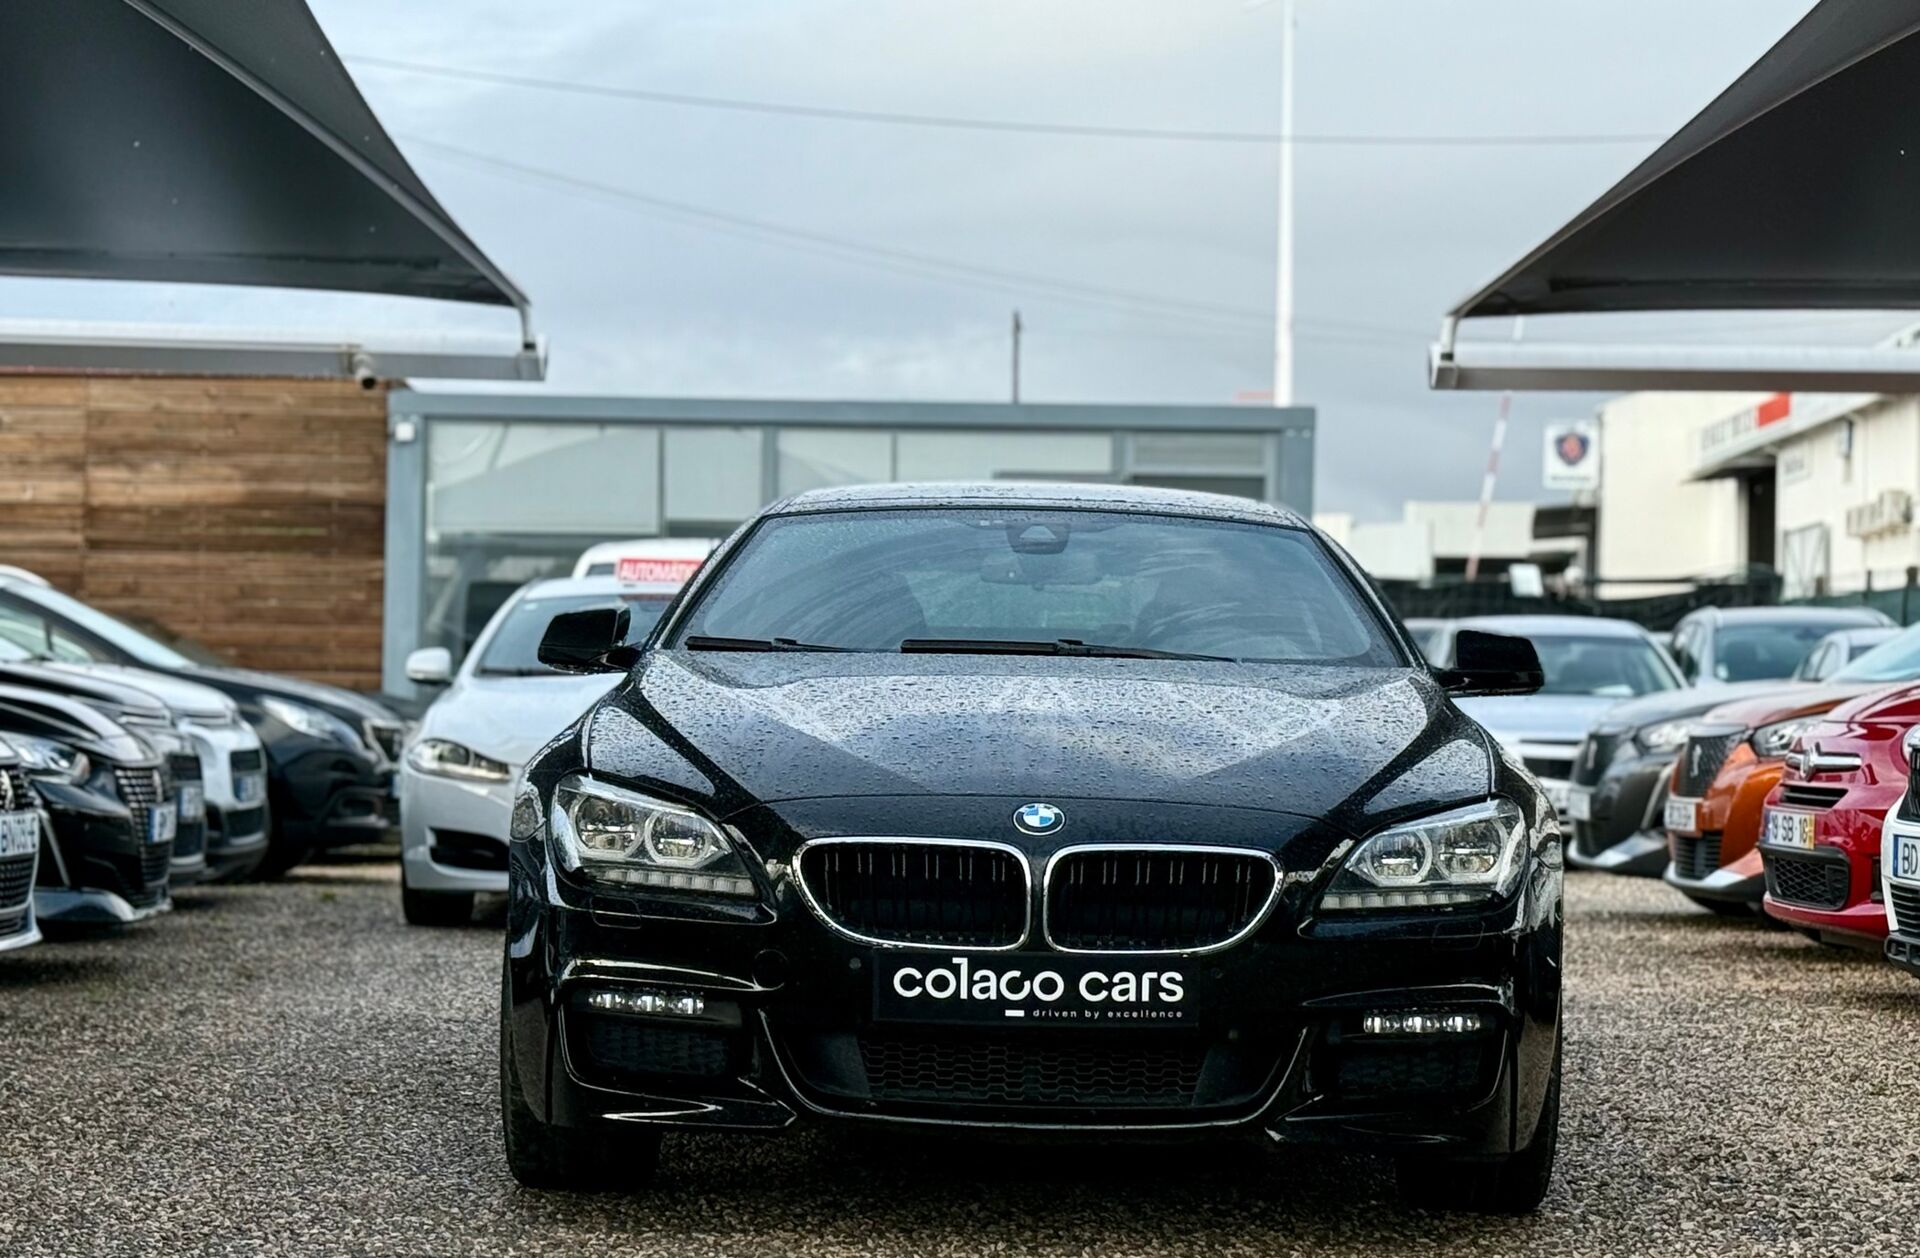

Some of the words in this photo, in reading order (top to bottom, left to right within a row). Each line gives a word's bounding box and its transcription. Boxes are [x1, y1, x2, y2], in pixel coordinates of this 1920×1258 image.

[1781, 815, 1794, 843] SB
[1902, 843, 1919, 875] BD
[1078, 971, 1184, 1003] cars
[1032, 1009, 1077, 1018] driven
[1084, 1010, 1100, 1019] by
[1107, 1010, 1183, 1018] excellence
